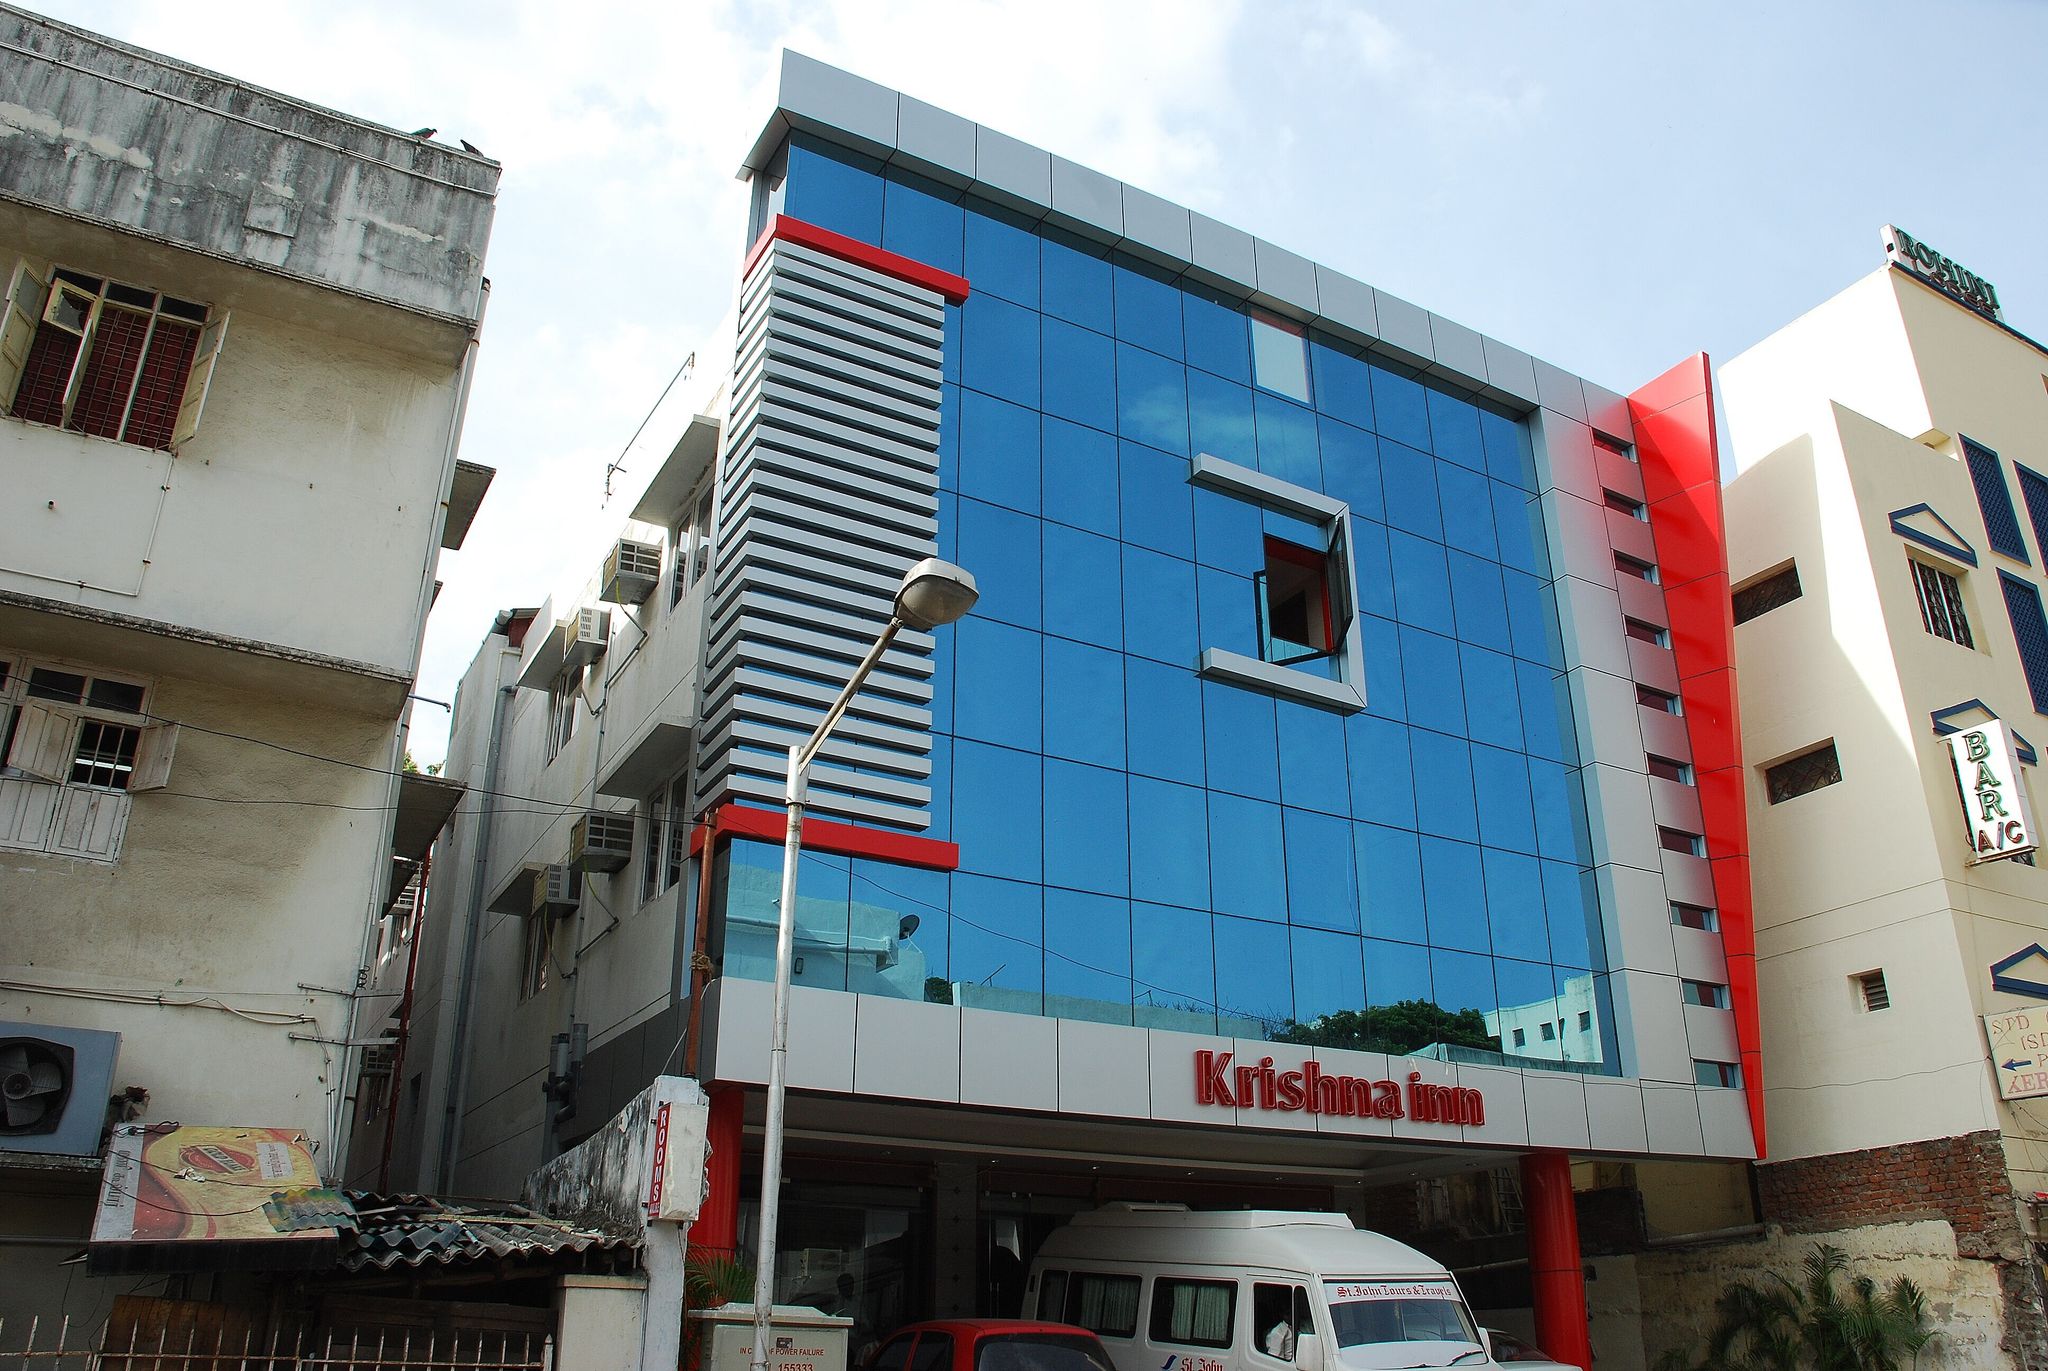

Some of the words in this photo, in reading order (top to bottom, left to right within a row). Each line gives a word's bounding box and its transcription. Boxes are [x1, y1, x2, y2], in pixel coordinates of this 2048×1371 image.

[1895, 227, 2000, 310] ROHINI
[1962, 731, 2008, 821] BAR
[1978, 821, 2024, 852] A/C
[1195, 1049, 1405, 1120] Krishna
[1407, 1070, 1486, 1126] inn
[653, 1110, 667, 1201] ROOMS
[1380, 1284, 1412, 1296] Tours
[1418, 1284, 1452, 1297] Travels
[775, 1348, 798, 1356] POWER
[799, 1348, 824, 1356] FAILURE
